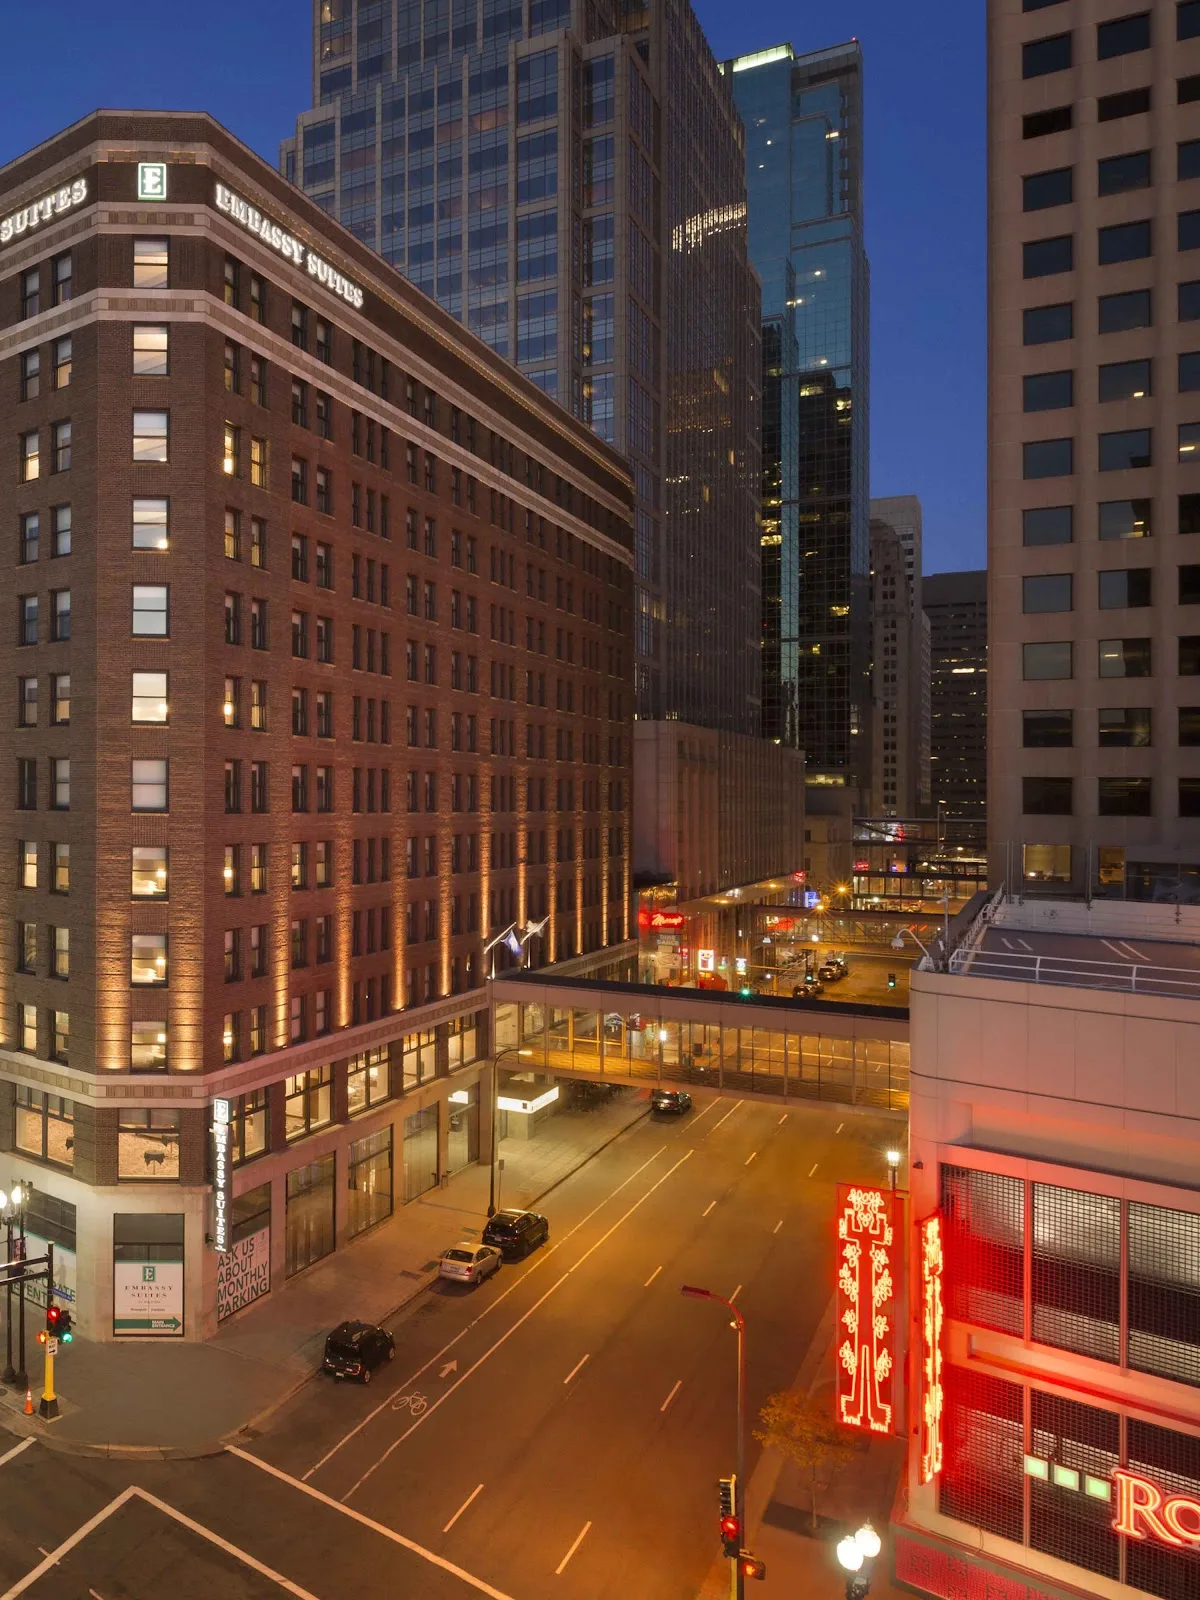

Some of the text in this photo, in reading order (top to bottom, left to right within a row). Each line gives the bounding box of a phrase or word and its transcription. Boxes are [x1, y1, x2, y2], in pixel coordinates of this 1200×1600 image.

[143, 167, 162, 194] E
[0, 178, 88, 242] SUITES
[215, 183, 364, 309] EMBASSY SUITES
[215, 1122, 226, 1188] EMBASSY
[215, 1190, 226, 1244] SUITES
[217, 1246, 238, 1270] ASK
[242, 1237, 255, 1256] US
[217, 1253, 254, 1287] ABOUT
[217, 1261, 268, 1303] MONTHLY
[217, 1278, 268, 1320] PARKING
